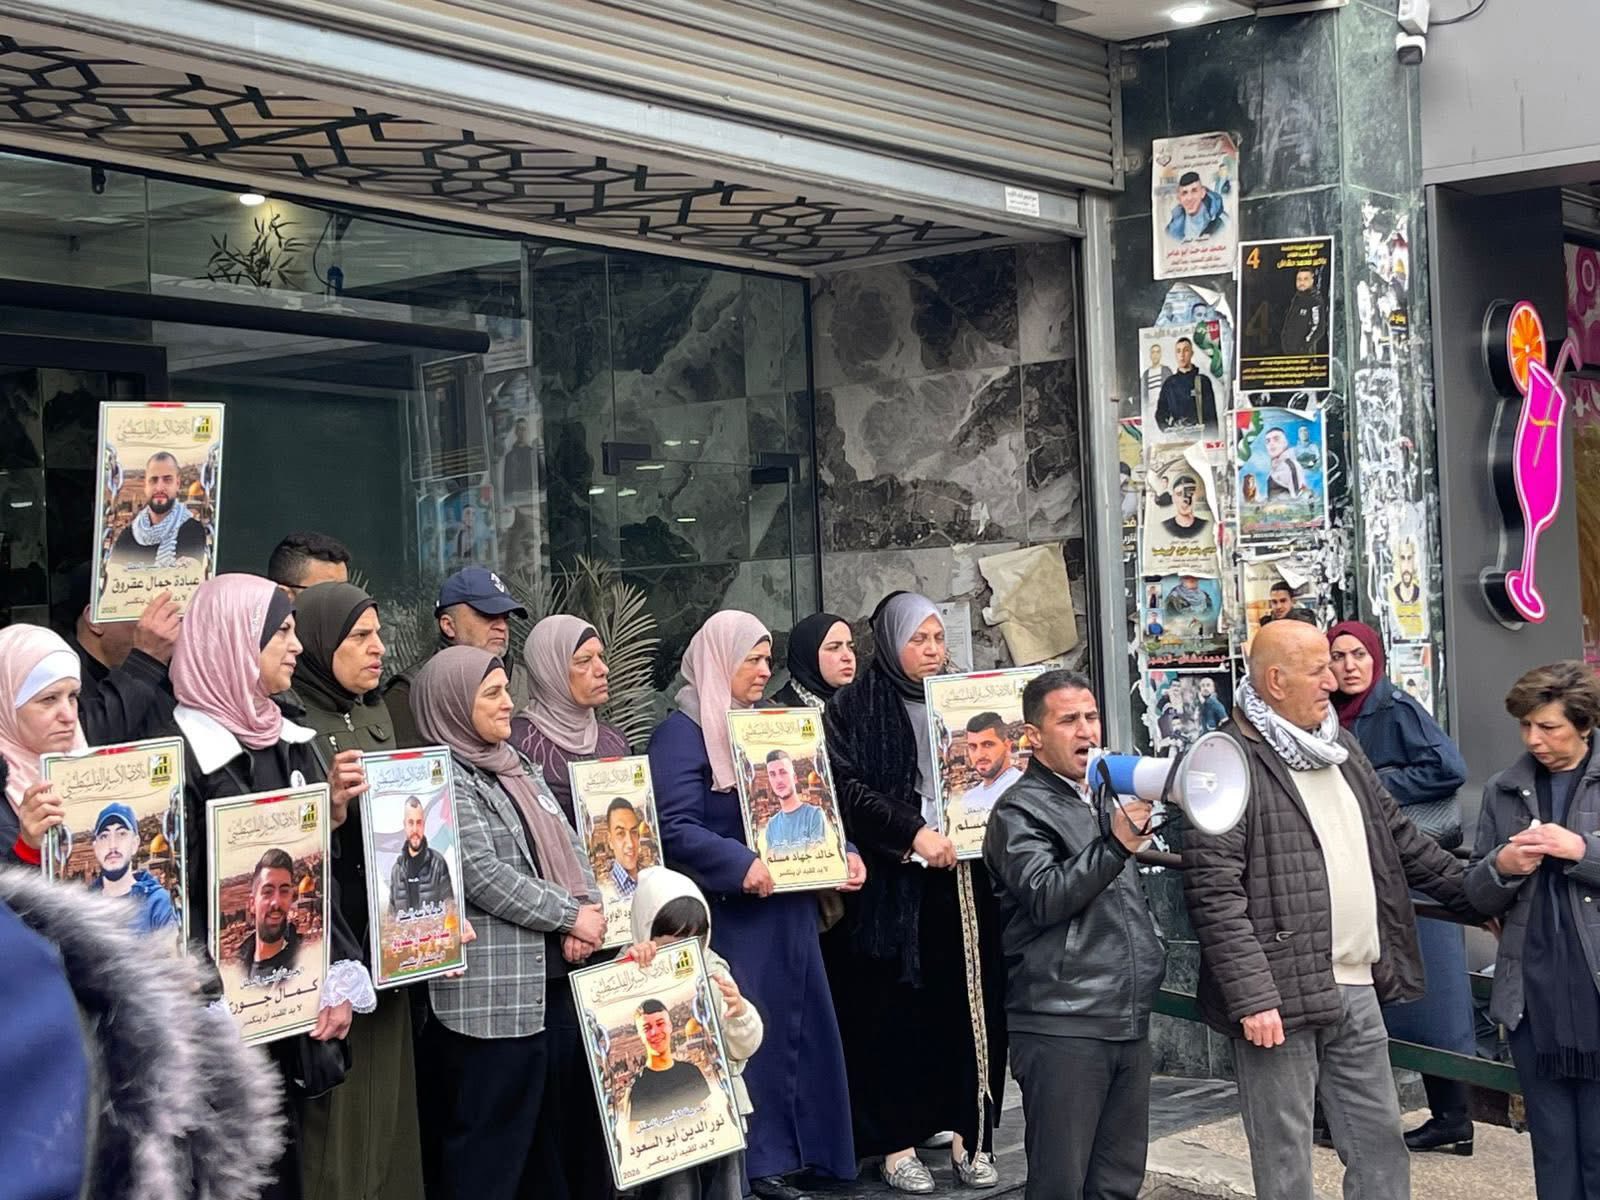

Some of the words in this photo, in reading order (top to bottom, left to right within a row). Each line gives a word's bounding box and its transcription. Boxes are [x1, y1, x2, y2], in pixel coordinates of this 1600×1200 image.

[1246, 247, 1261, 269] 4
[1246, 300, 1272, 346] 4
[145, 575, 172, 592] جمال
[273, 978, 319, 1004] كمال
[680, 1120, 708, 1142] الدين
[709, 1113, 726, 1133] نور
[629, 1136, 664, 1158] السعود
[664, 1127, 680, 1148] أبو
